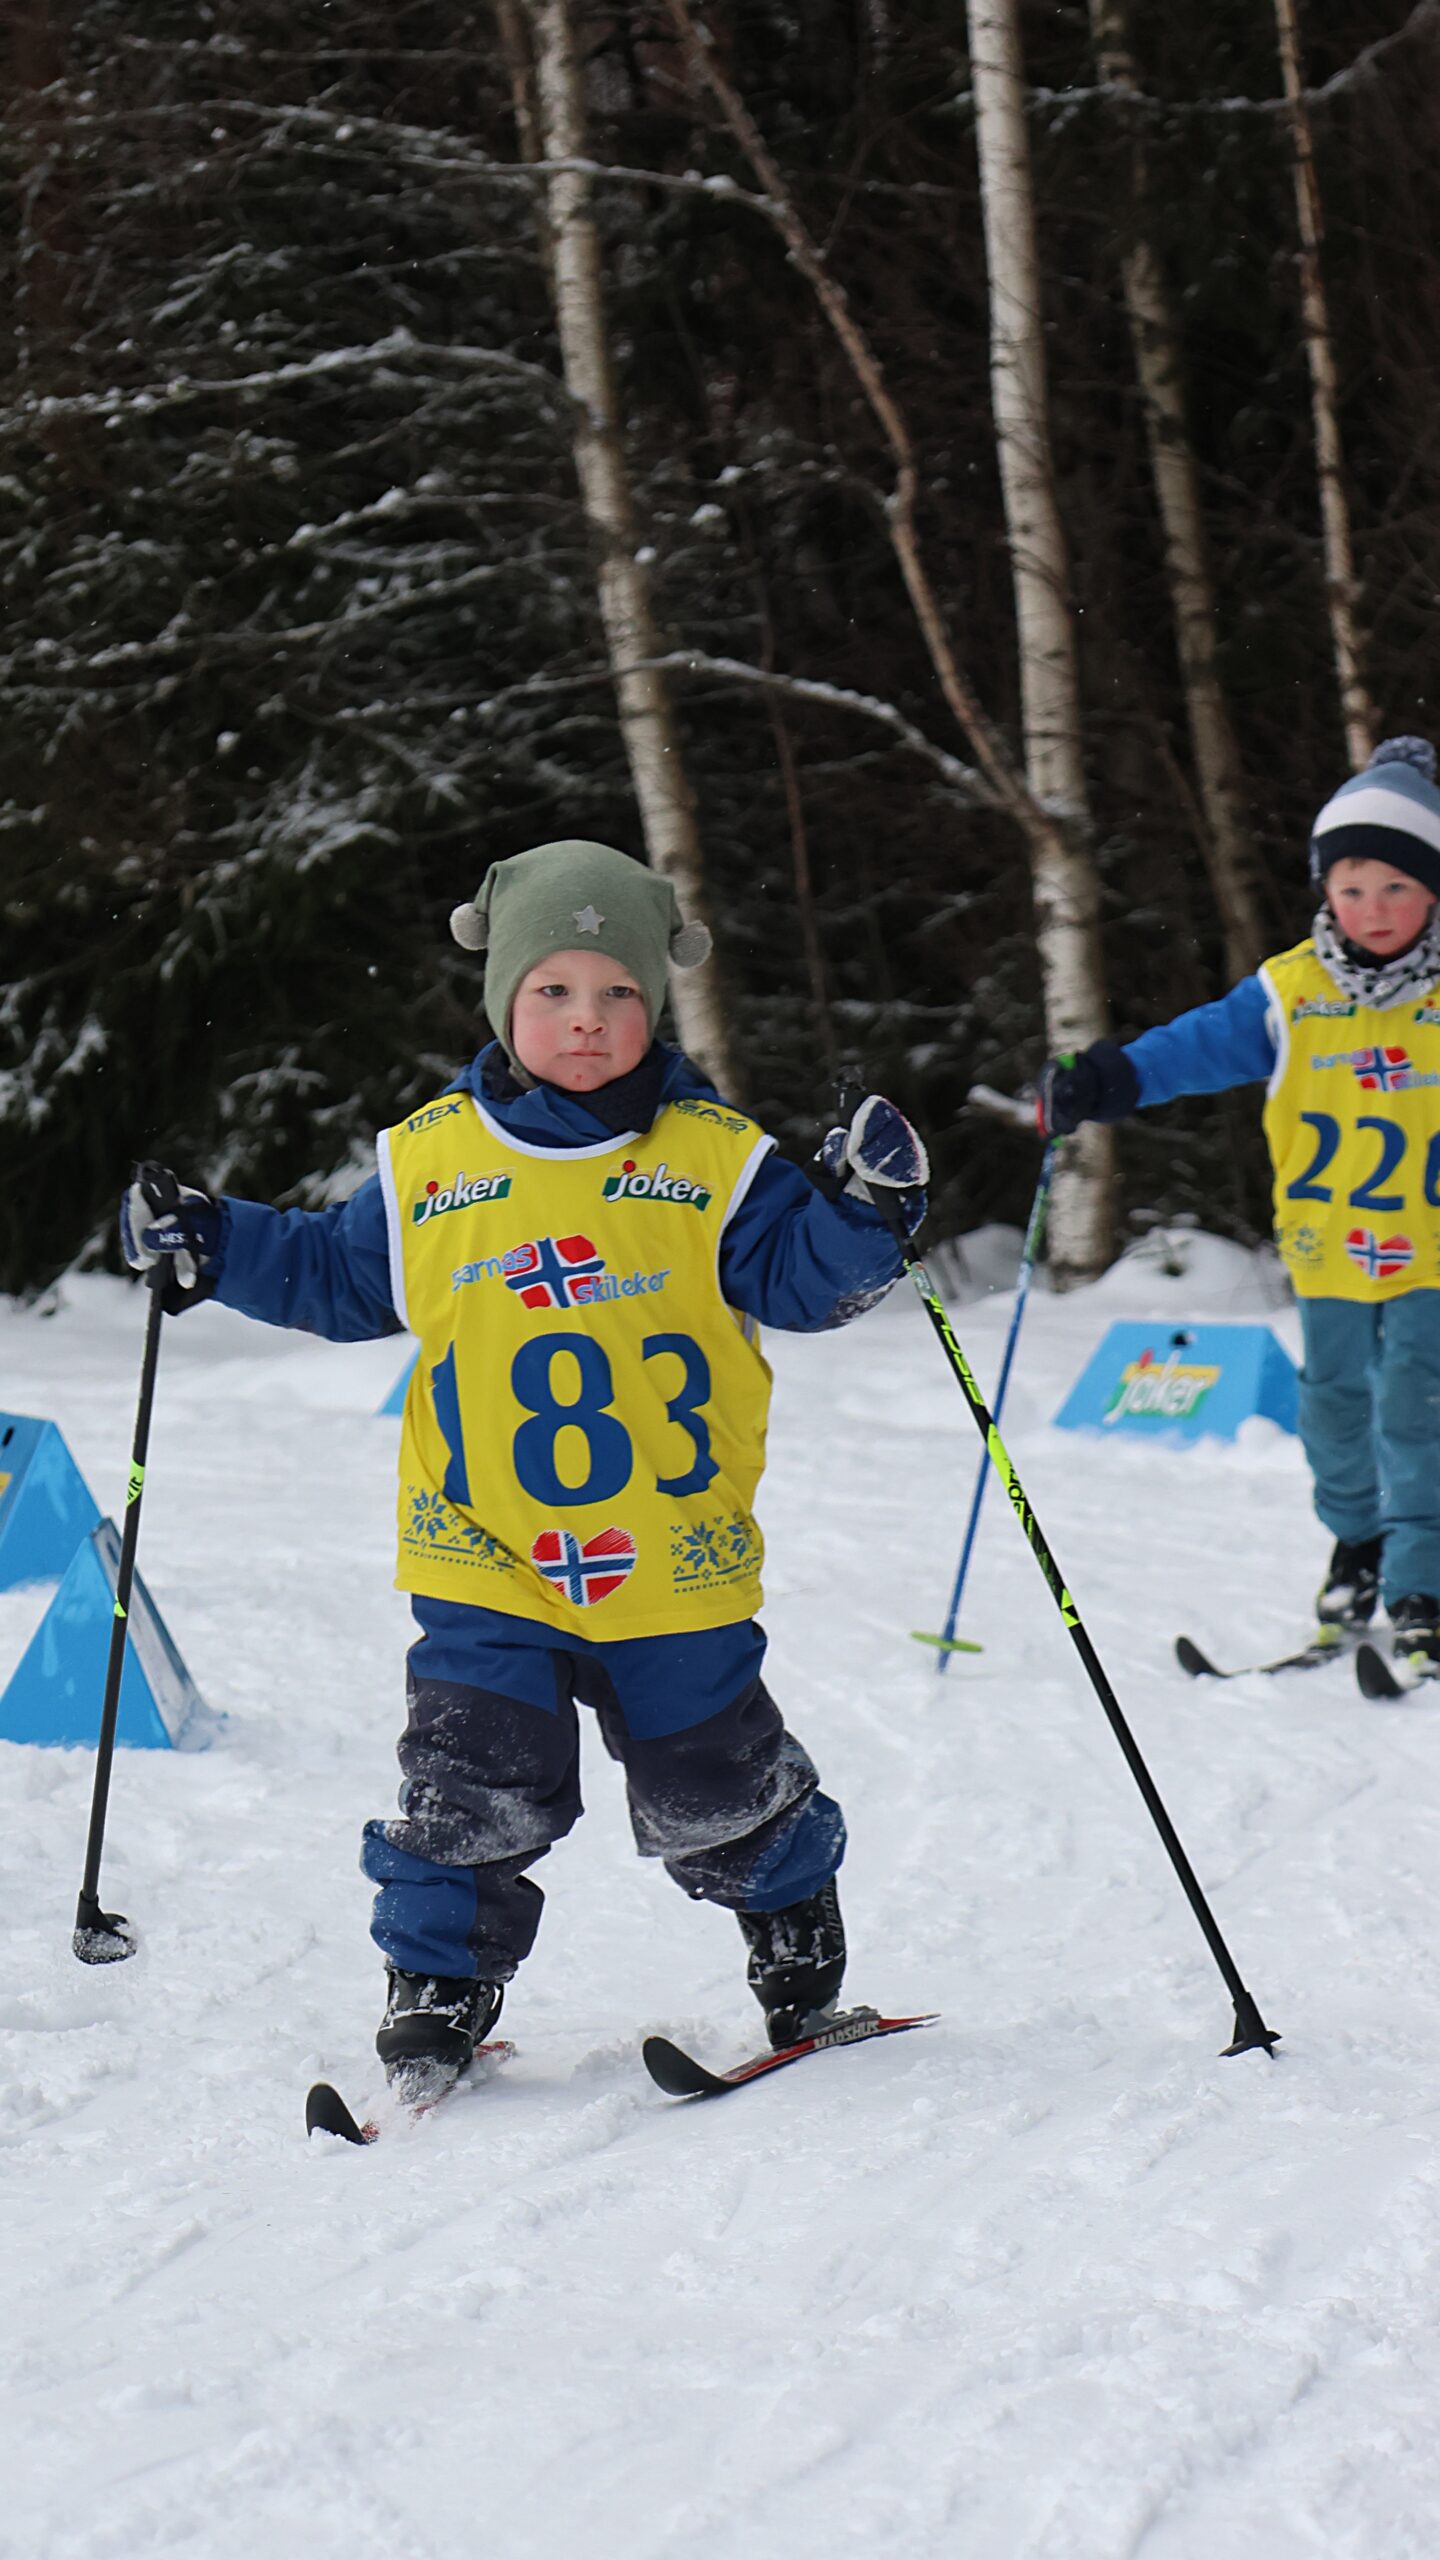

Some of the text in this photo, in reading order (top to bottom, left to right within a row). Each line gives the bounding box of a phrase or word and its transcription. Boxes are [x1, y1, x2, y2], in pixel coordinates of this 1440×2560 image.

[415, 1169, 508, 1227] joker
[606, 1159, 708, 1203] joker
[1102, 1347, 1207, 1426] joker
